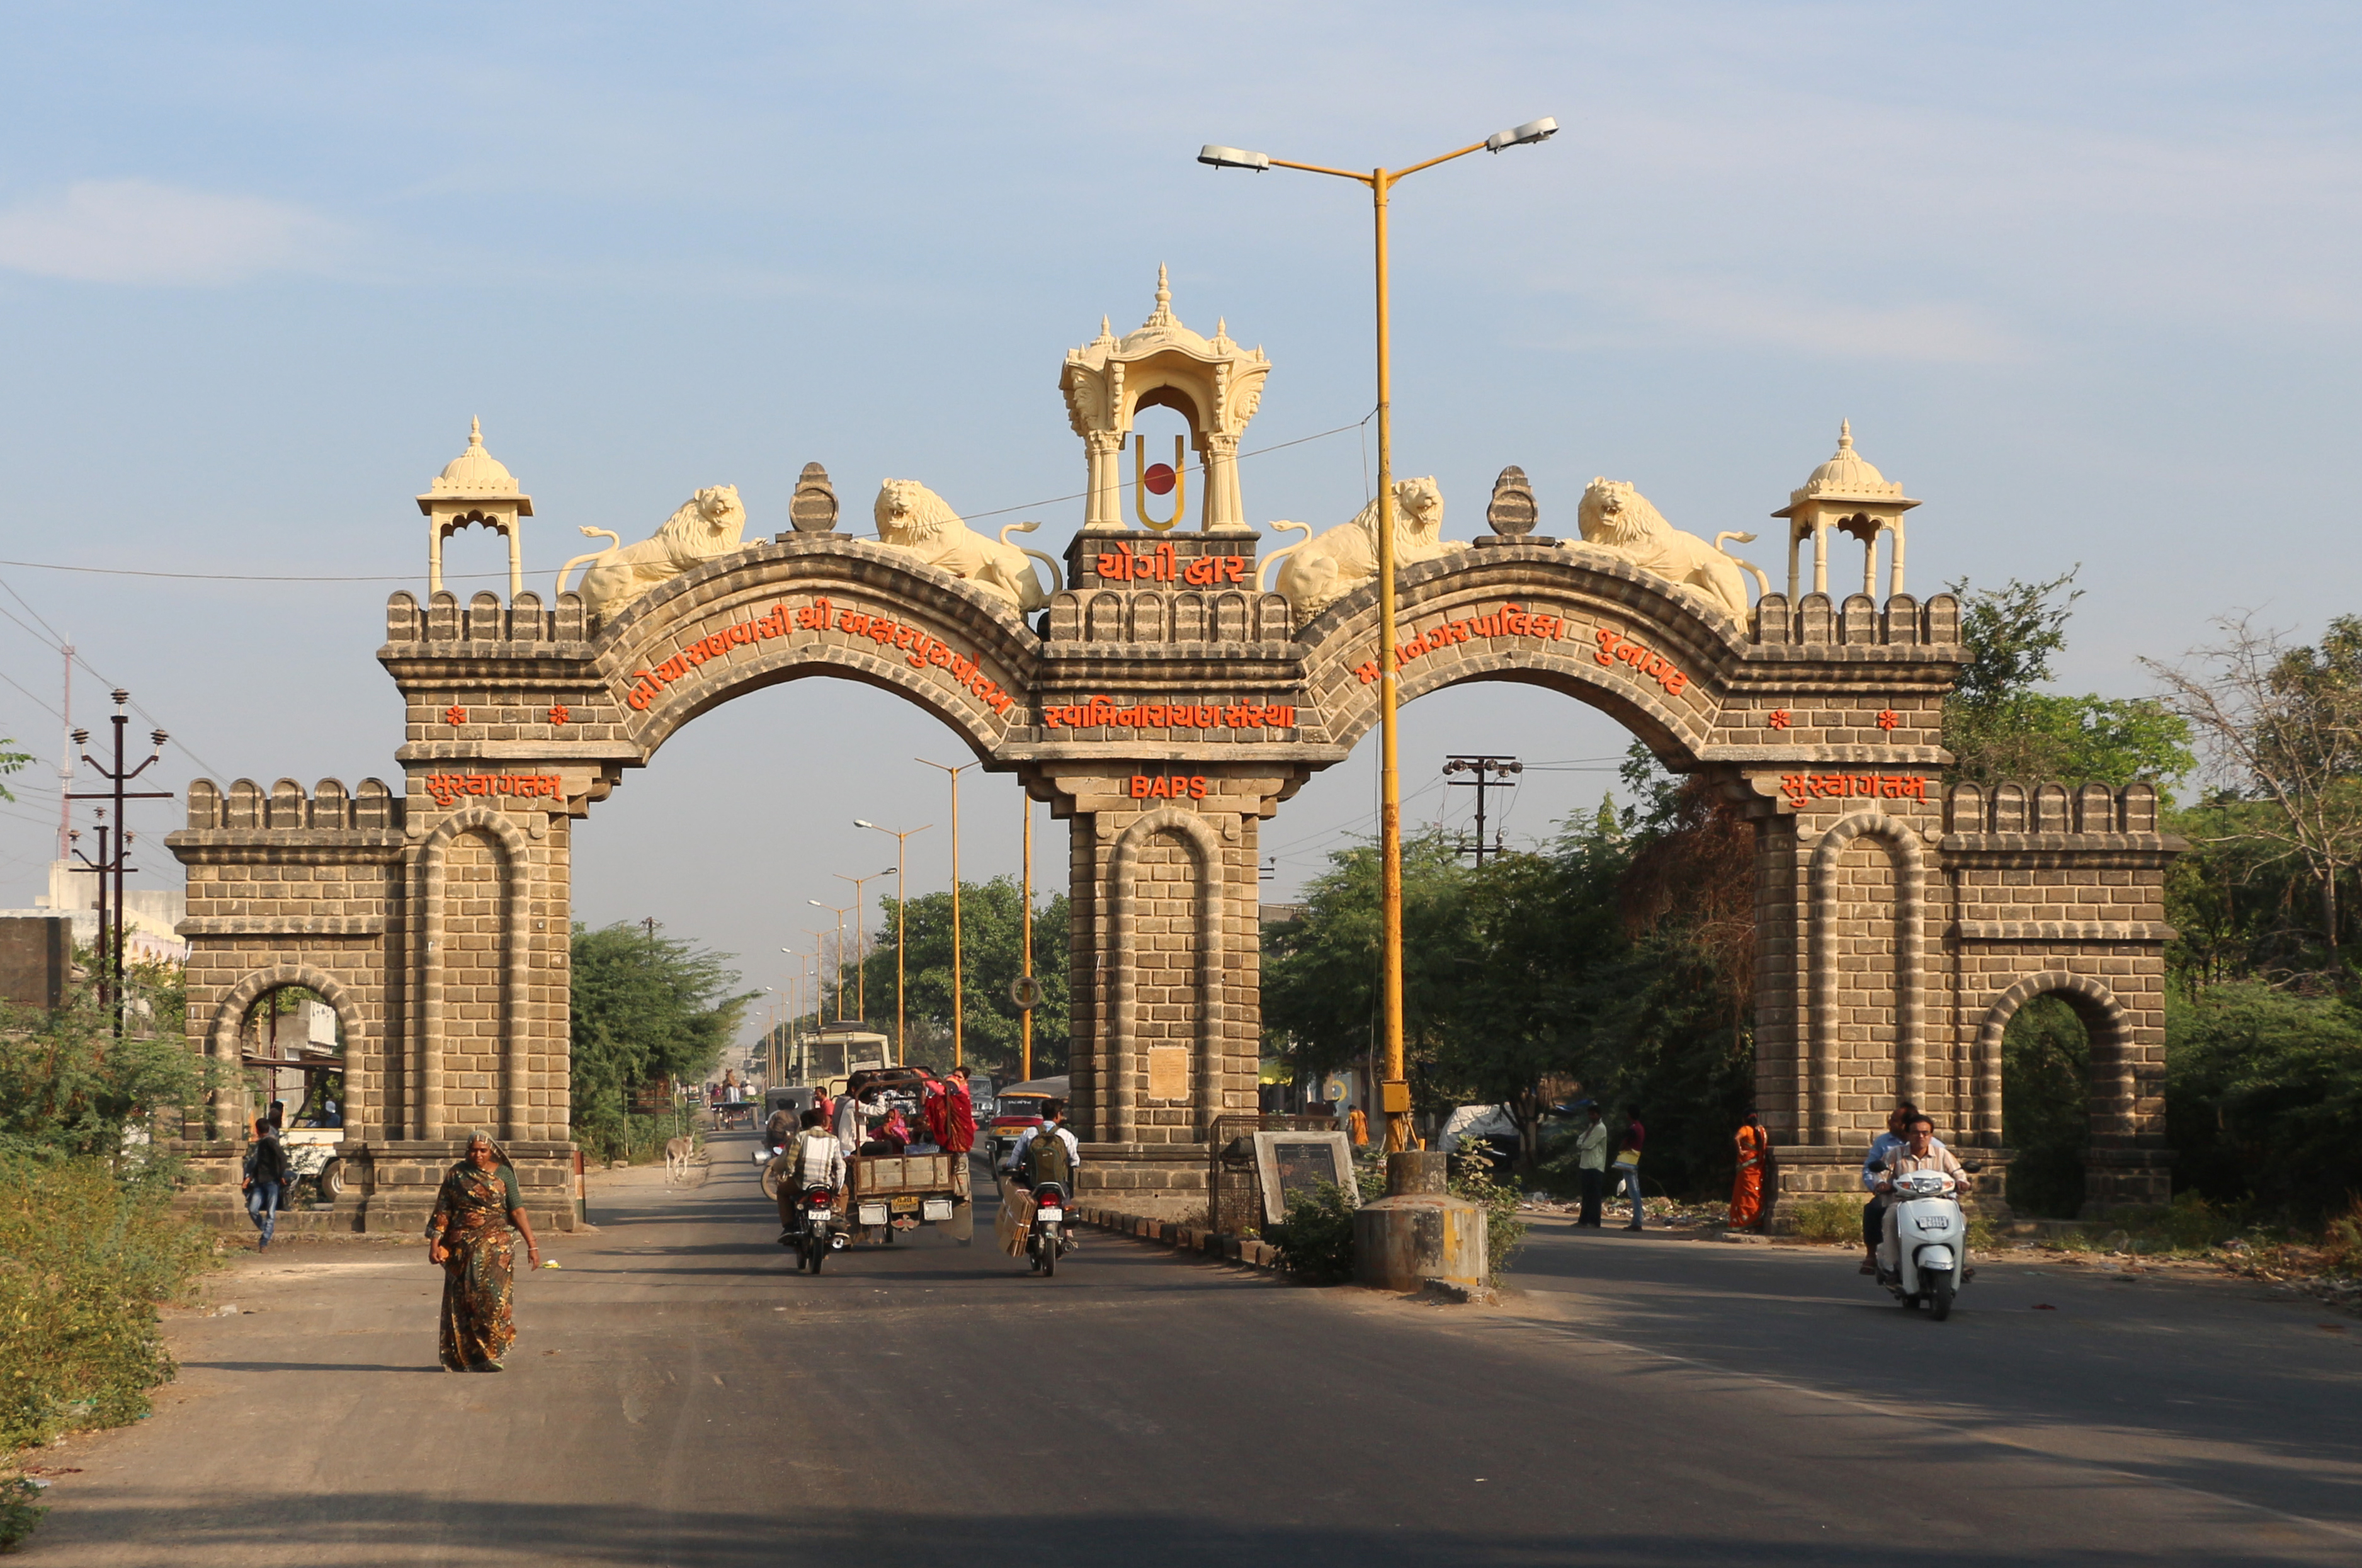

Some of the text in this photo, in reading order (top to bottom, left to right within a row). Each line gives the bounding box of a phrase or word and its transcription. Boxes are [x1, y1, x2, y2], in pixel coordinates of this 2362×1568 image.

[1097, 541, 1245, 586] યોગી દ્વાર
[627, 603, 793, 710] બોચાસણવાસી
[797, 597, 833, 630] શ્રી
[1353, 602, 1564, 685] માનગરપાલિકા
[1045, 694, 1295, 729] સ્વામિનારાયણ સંસ્થા
[426, 774, 564, 806] सुस्वागतम्
[1131, 775, 1209, 799] BAPS
[1781, 774, 1929, 808] सुस्वागतम्
